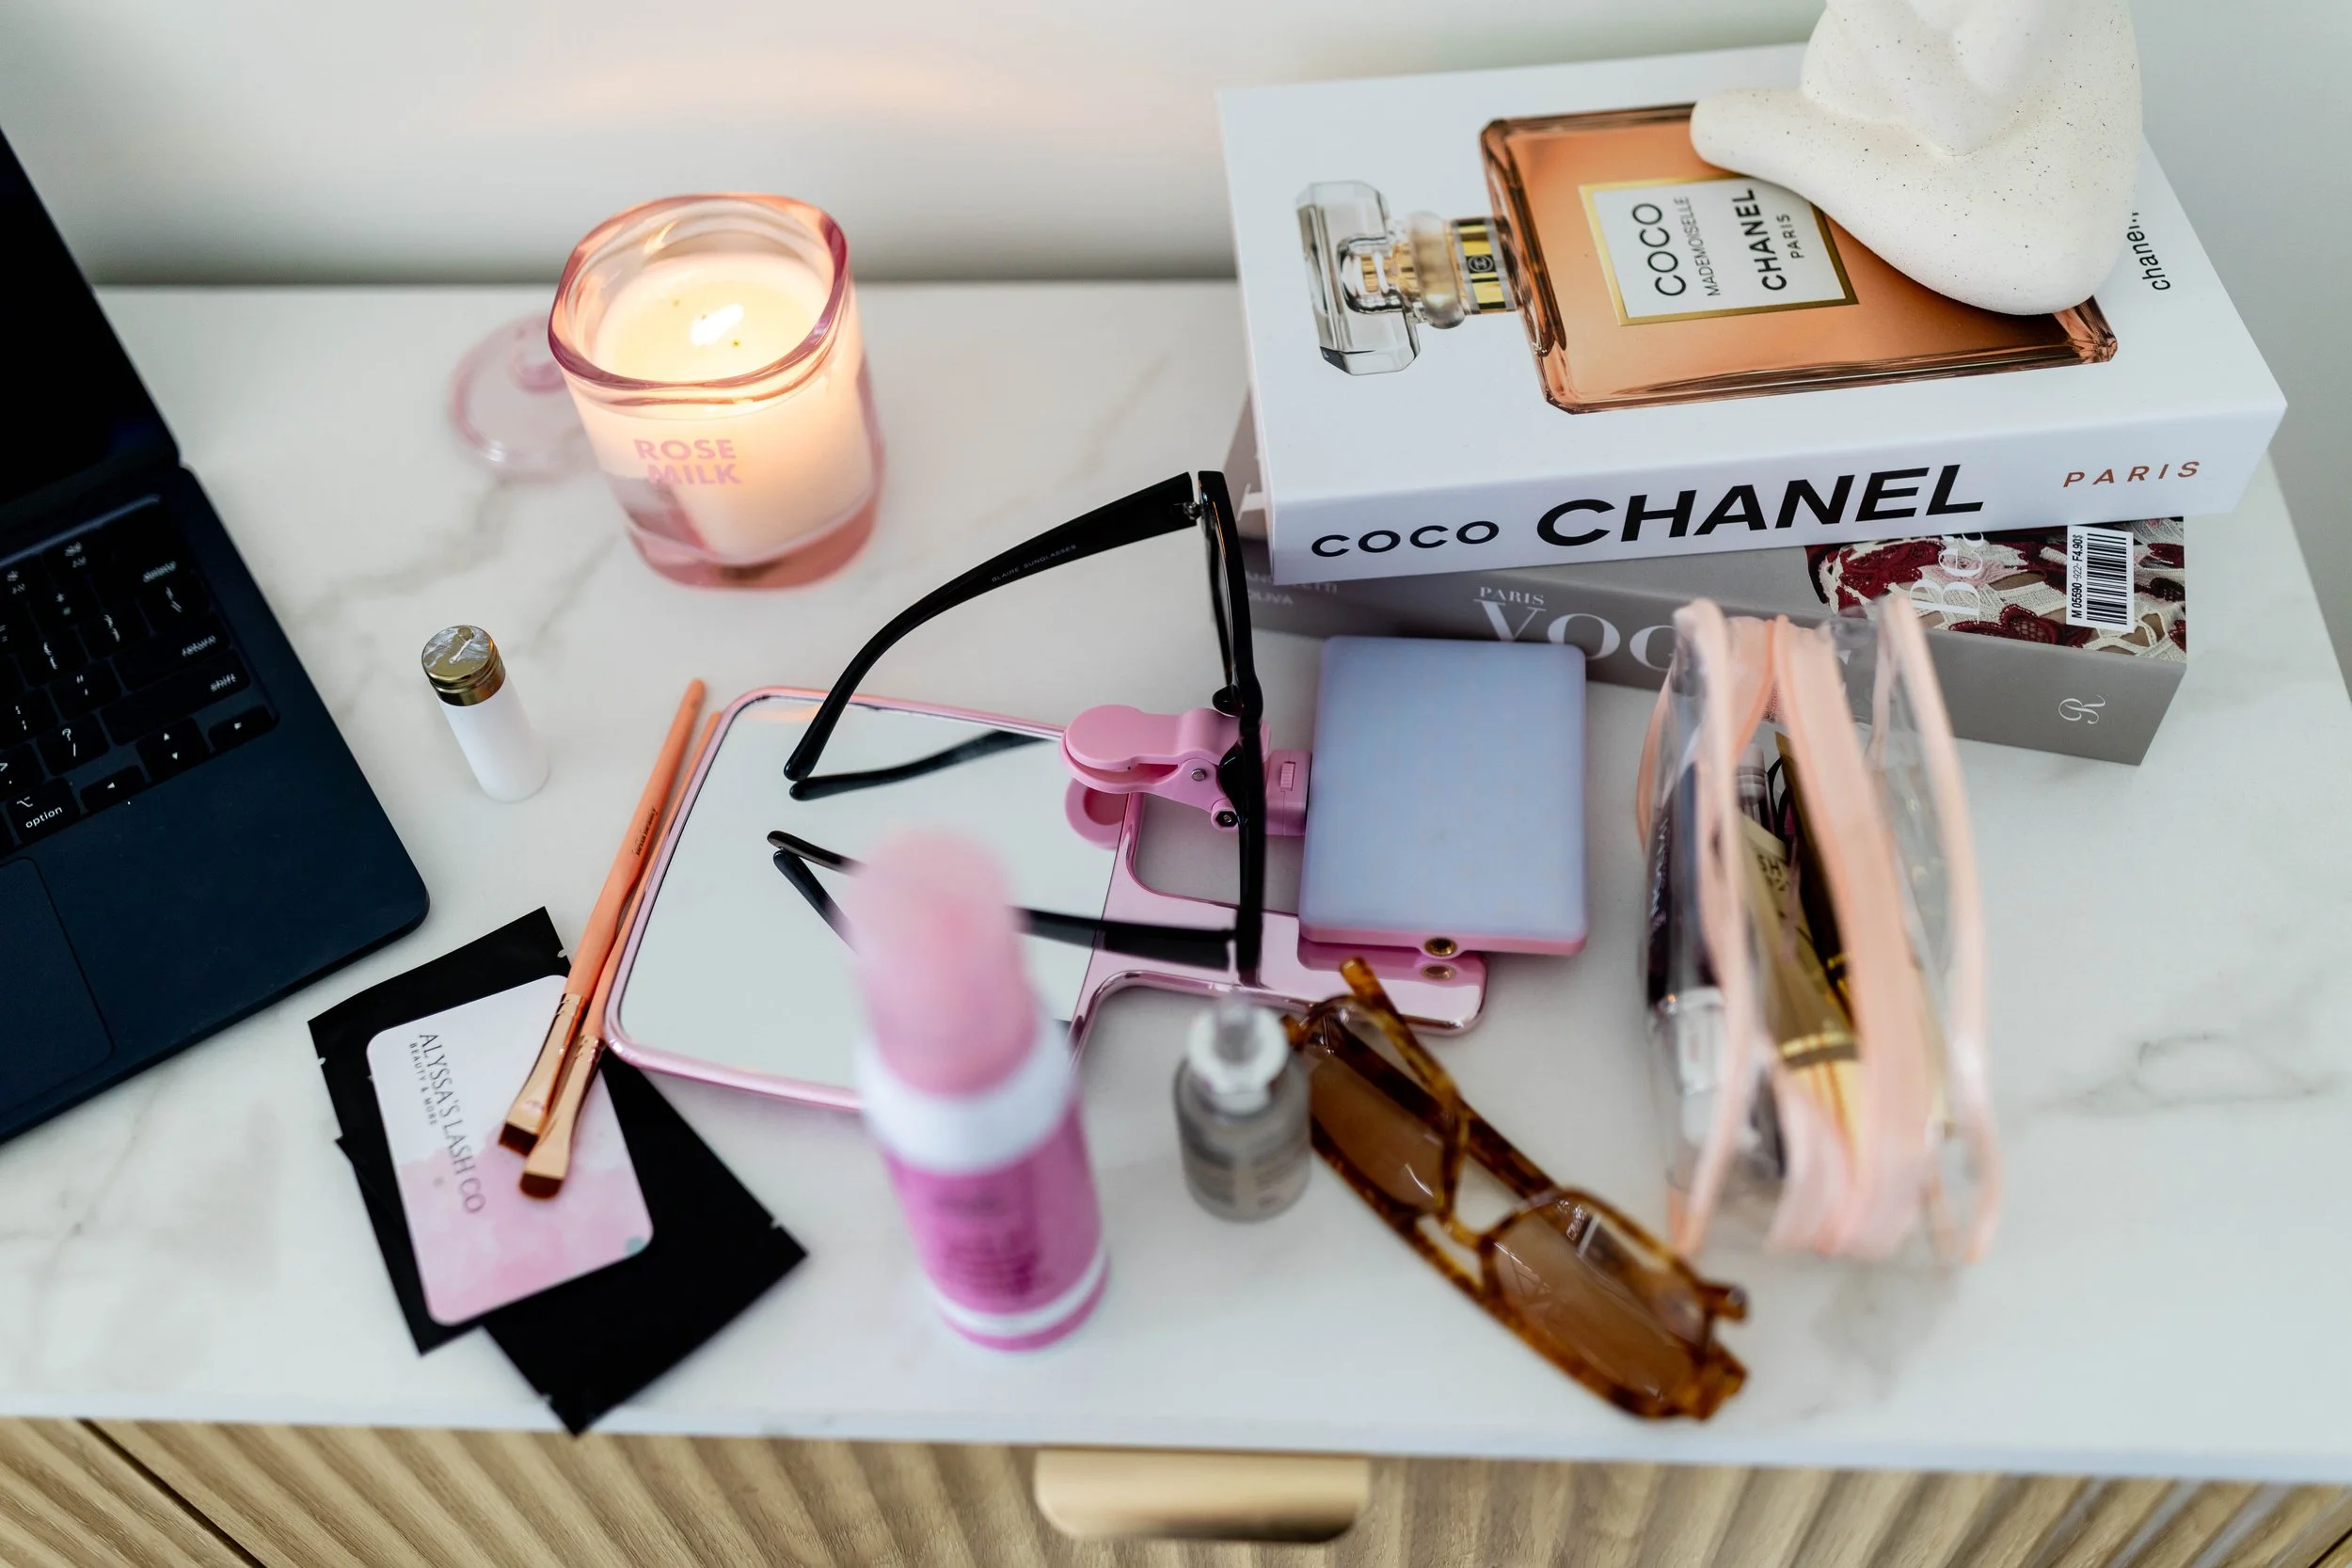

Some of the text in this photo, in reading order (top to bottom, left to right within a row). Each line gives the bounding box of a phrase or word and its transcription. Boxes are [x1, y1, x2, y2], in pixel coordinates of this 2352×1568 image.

[1631, 203, 1686, 296] COCO
[1674, 196, 1721, 296] MADEMOISELLE
[1732, 188, 1787, 291] CHANEL
[1776, 213, 1804, 259] PARIS
[633, 438, 737, 461] ROSE
[647, 463, 742, 484] MILK
[1311, 461, 2200, 558] COCO CHANEL PARIS
[1480, 586, 1545, 606] PARIS
[2072, 582, 2082, 609] 05590
[25, 806, 63, 828] option
[420, 1034, 486, 1213] ALYSSA'S LASH CO
